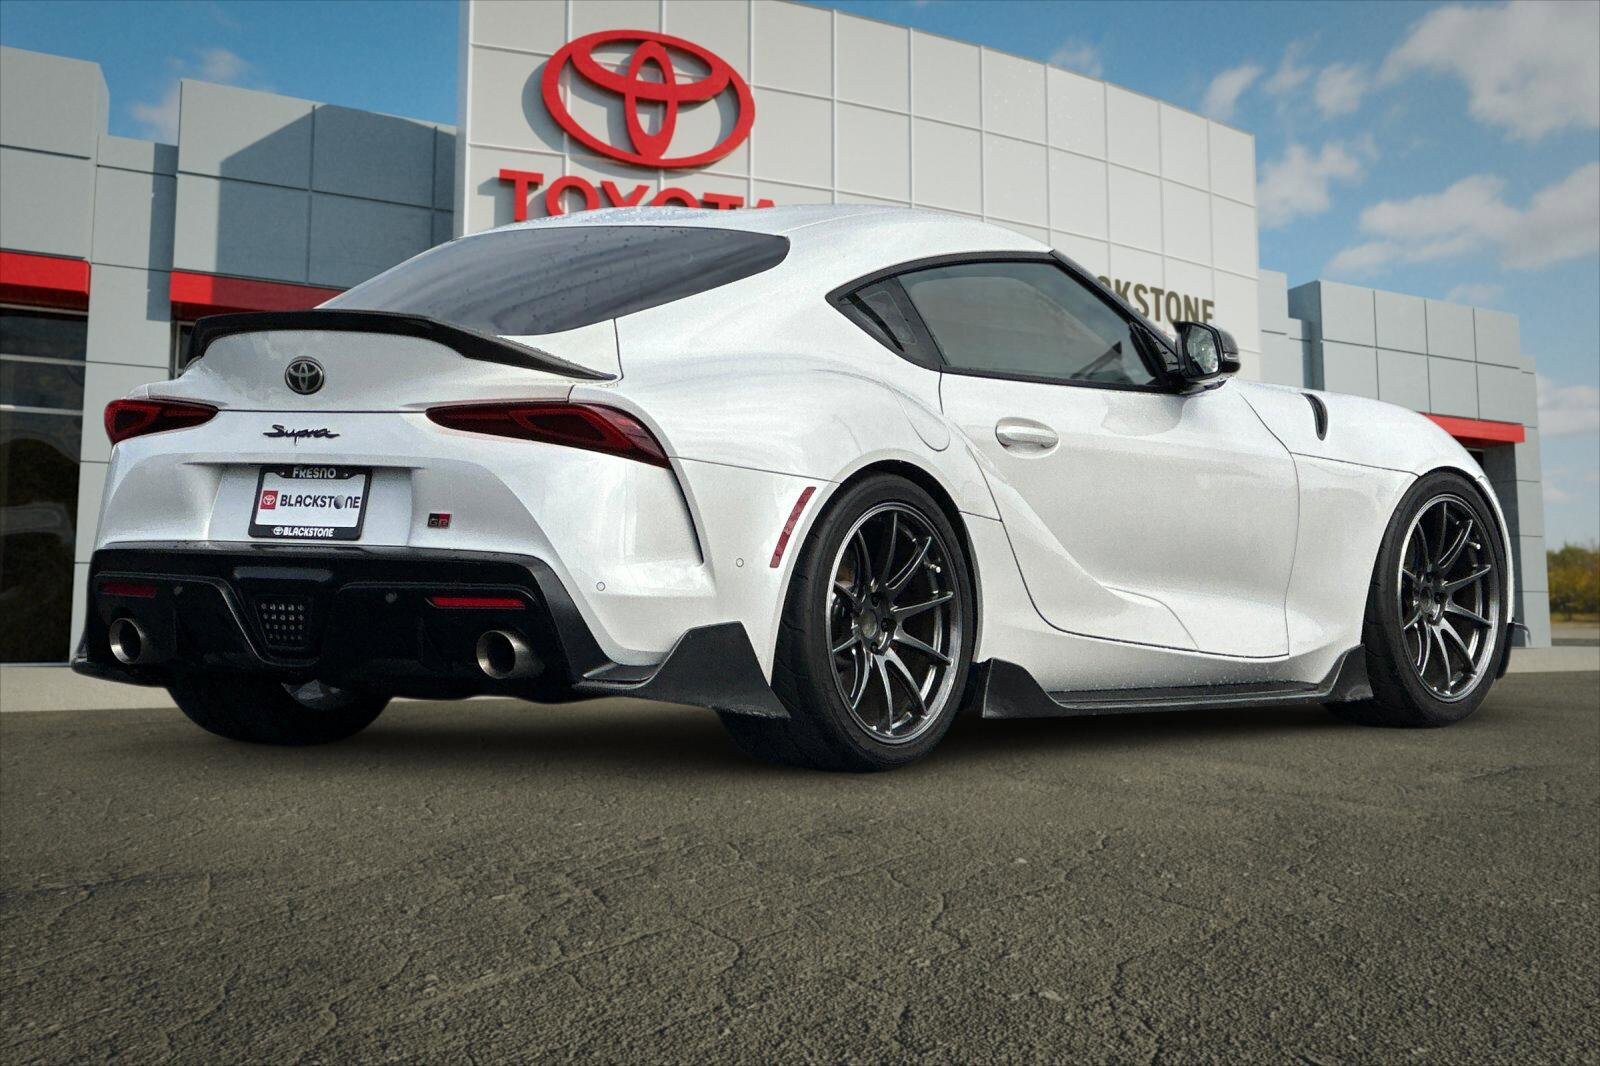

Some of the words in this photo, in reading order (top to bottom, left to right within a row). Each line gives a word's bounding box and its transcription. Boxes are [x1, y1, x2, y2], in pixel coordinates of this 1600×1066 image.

[499, 168, 777, 222] TOY
[263, 424, 340, 446] Supra
[292, 467, 337, 479] FRESNO
[280, 494, 361, 510] BLACKSTONE
[283, 527, 335, 537] BLACKSTONE
